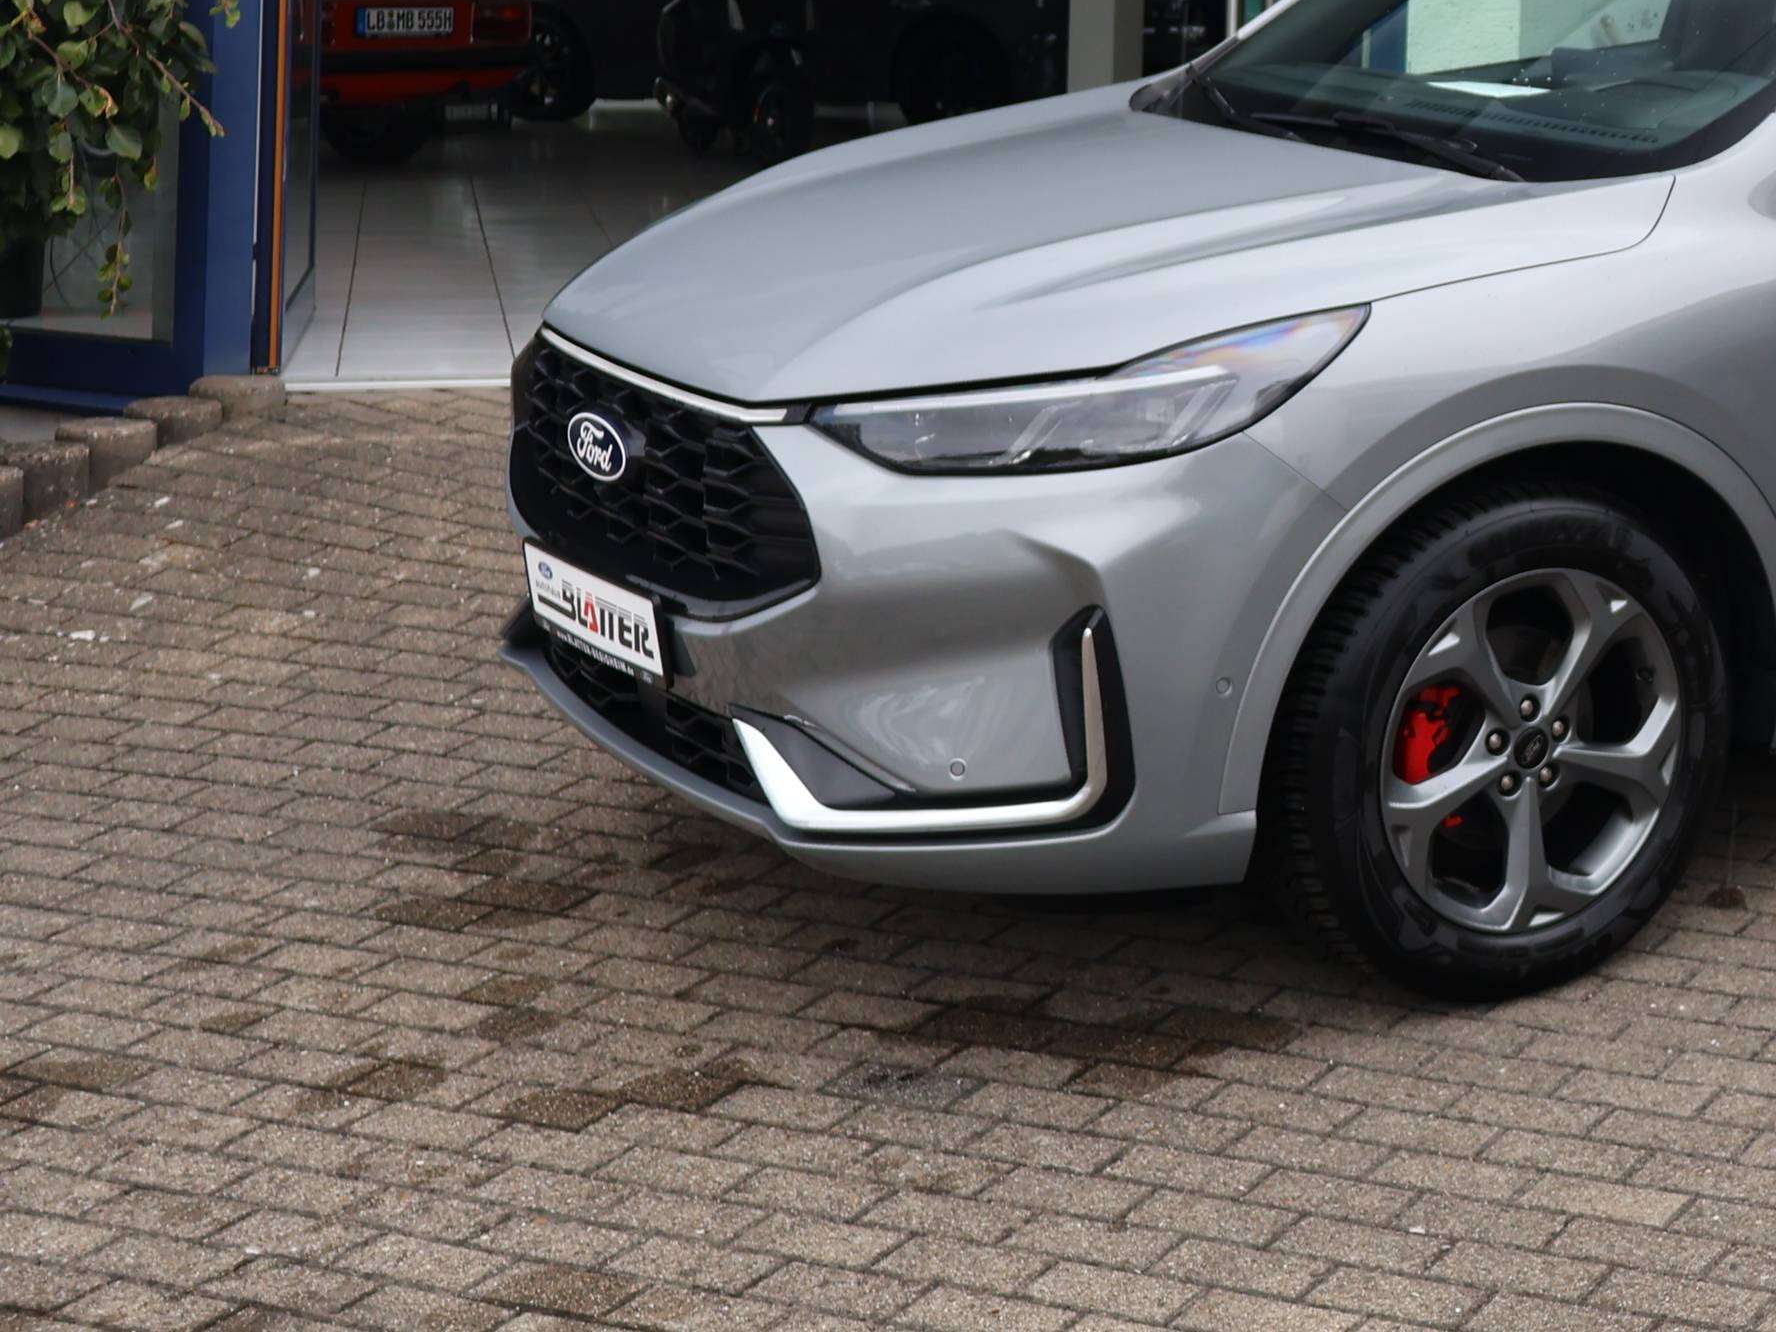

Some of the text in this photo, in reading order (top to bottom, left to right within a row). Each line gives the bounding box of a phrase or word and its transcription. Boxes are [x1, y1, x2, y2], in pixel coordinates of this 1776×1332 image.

[367, 10, 385, 30] LB
[397, 10, 414, 30] MB
[577, 421, 613, 472] Ford
